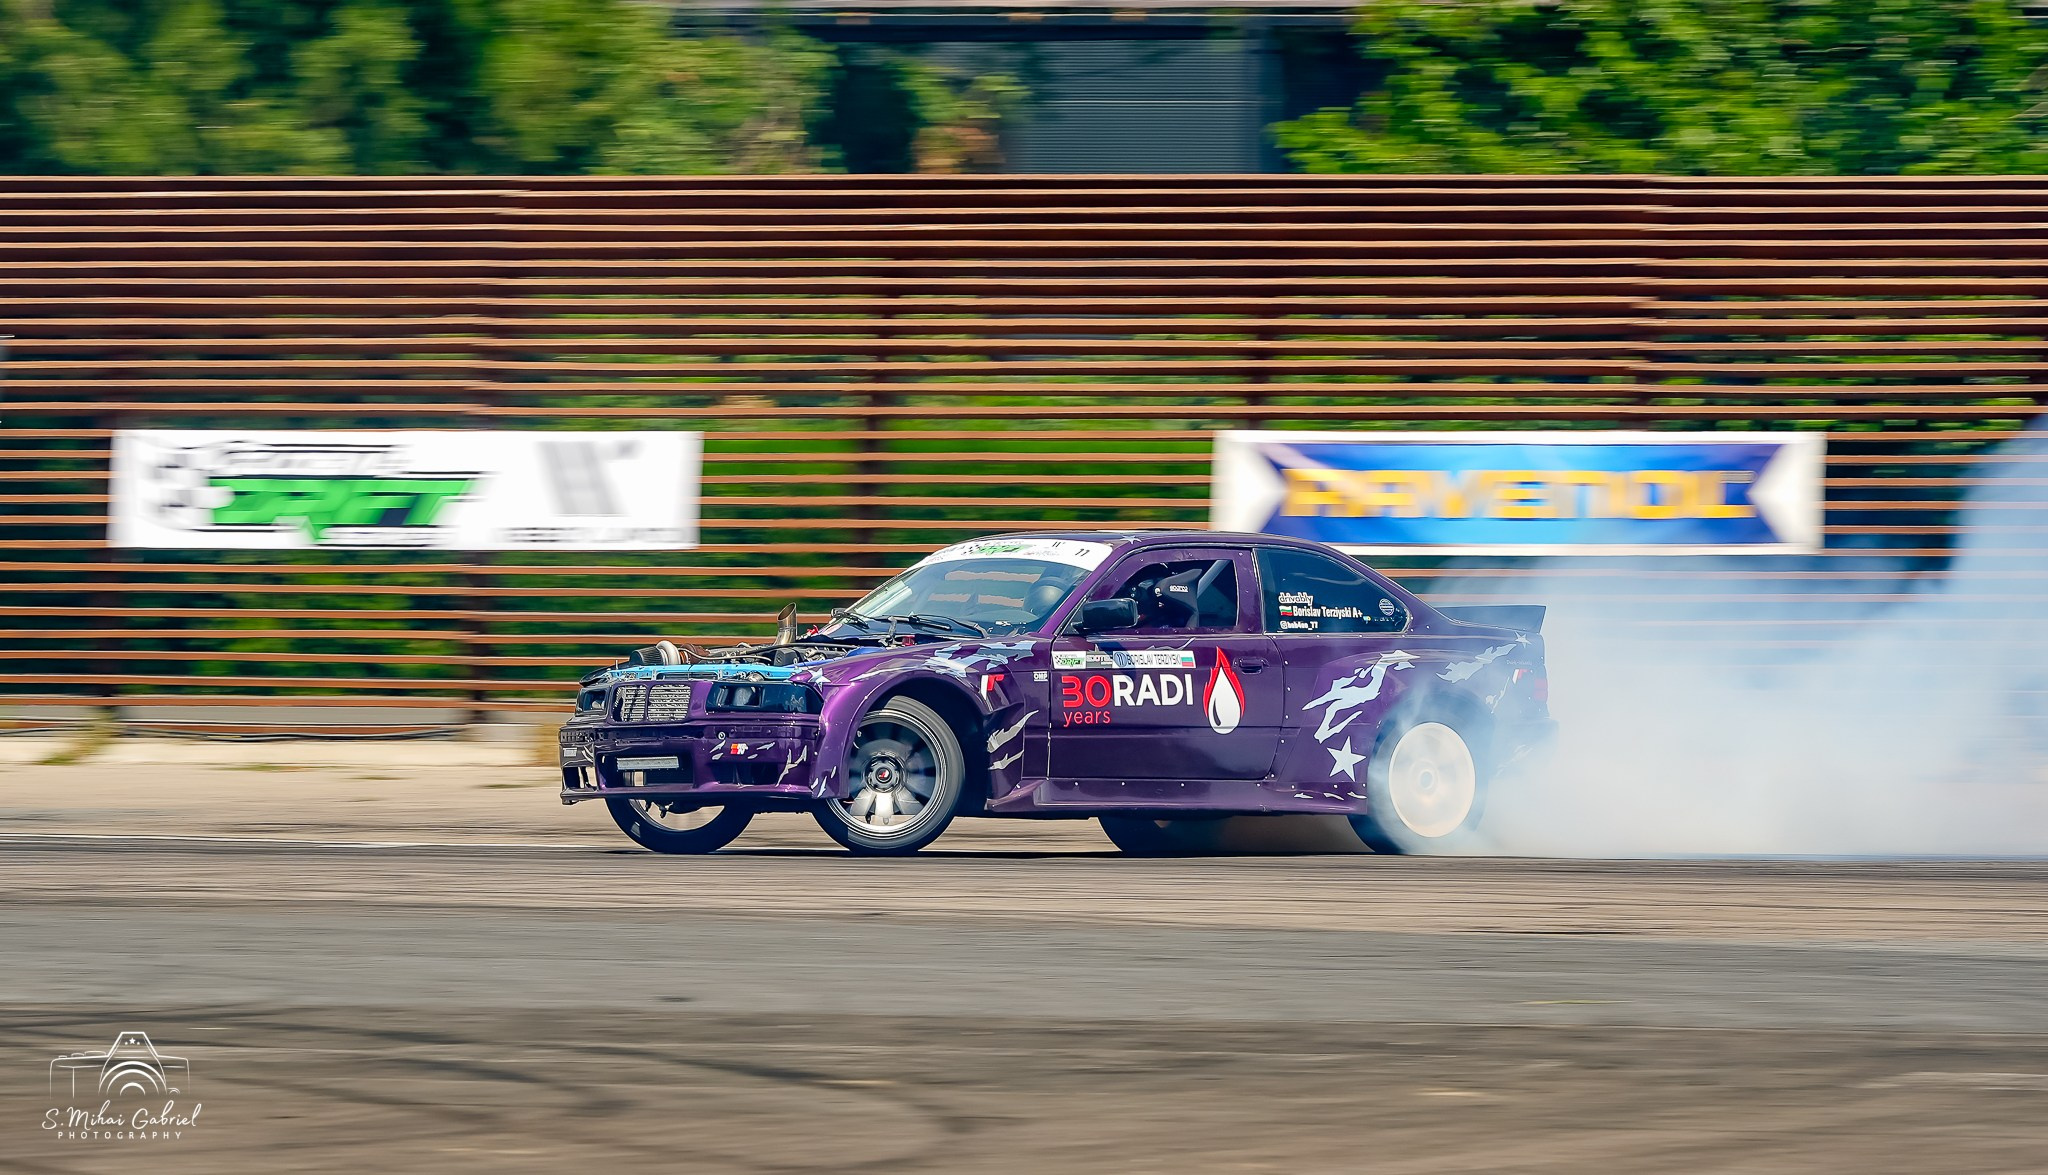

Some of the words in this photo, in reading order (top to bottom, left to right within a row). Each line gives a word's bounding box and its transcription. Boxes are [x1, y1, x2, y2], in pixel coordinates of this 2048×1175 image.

[1293, 606, 1320, 617] Borislav
[1321, 607, 1351, 619] Terziyski
[1353, 607, 1363, 618] A+
[1063, 710, 1111, 728] years
